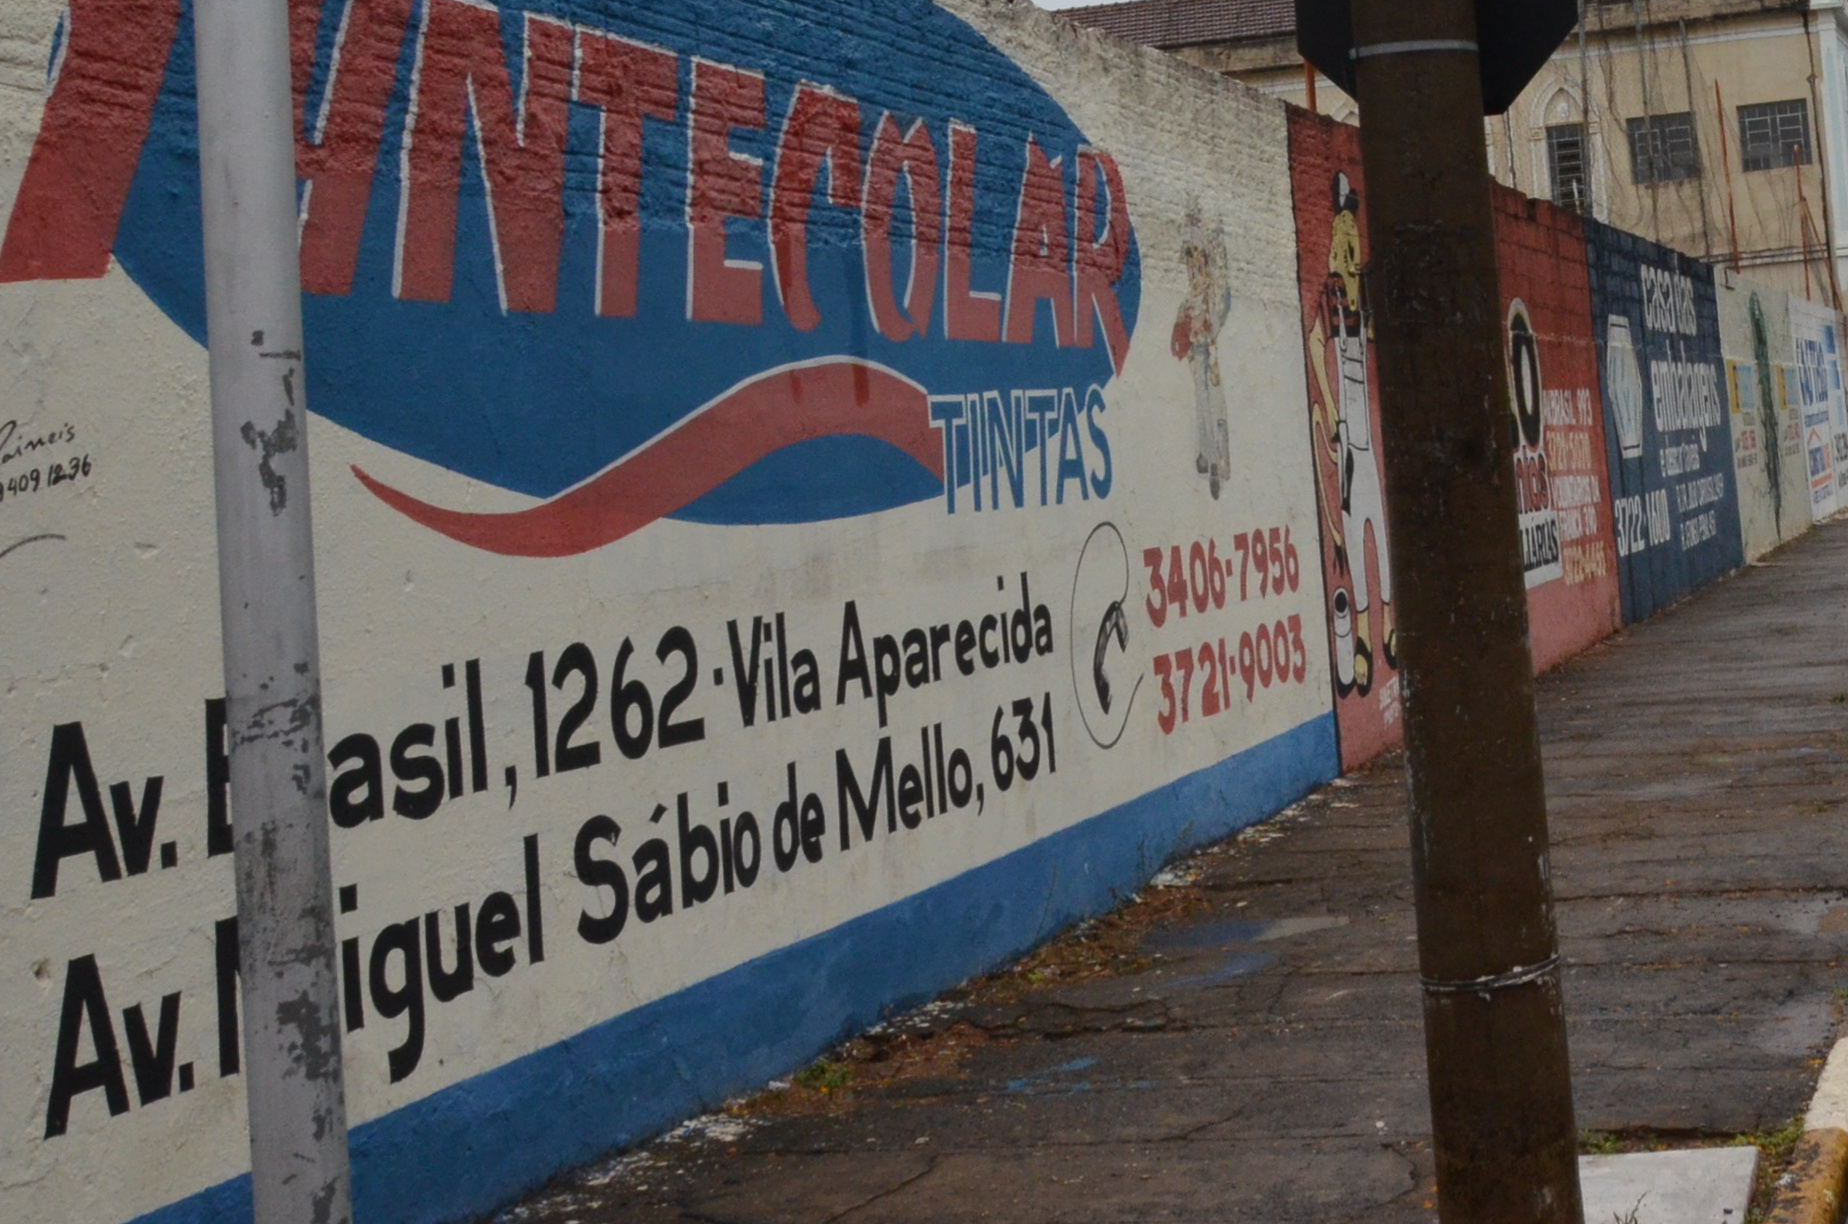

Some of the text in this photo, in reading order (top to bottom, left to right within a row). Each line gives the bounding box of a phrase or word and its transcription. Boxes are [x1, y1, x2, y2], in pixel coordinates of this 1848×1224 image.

[1641, 263, 1676, 333] casa
[928, 386, 1114, 516] TINTAS
[1651, 339, 1722, 453] embalagens
[30, 720, 179, 900] Av.
[206, 657, 518, 859] asil,
[727, 610, 822, 727] Vila
[836, 571, 1055, 728] Aparecida
[44, 953, 195, 1141] Av.
[574, 780, 763, 944] Sábio
[771, 761, 824, 873] de
[836, 721, 985, 852] Mello,
[989, 690, 1057, 792] 631
